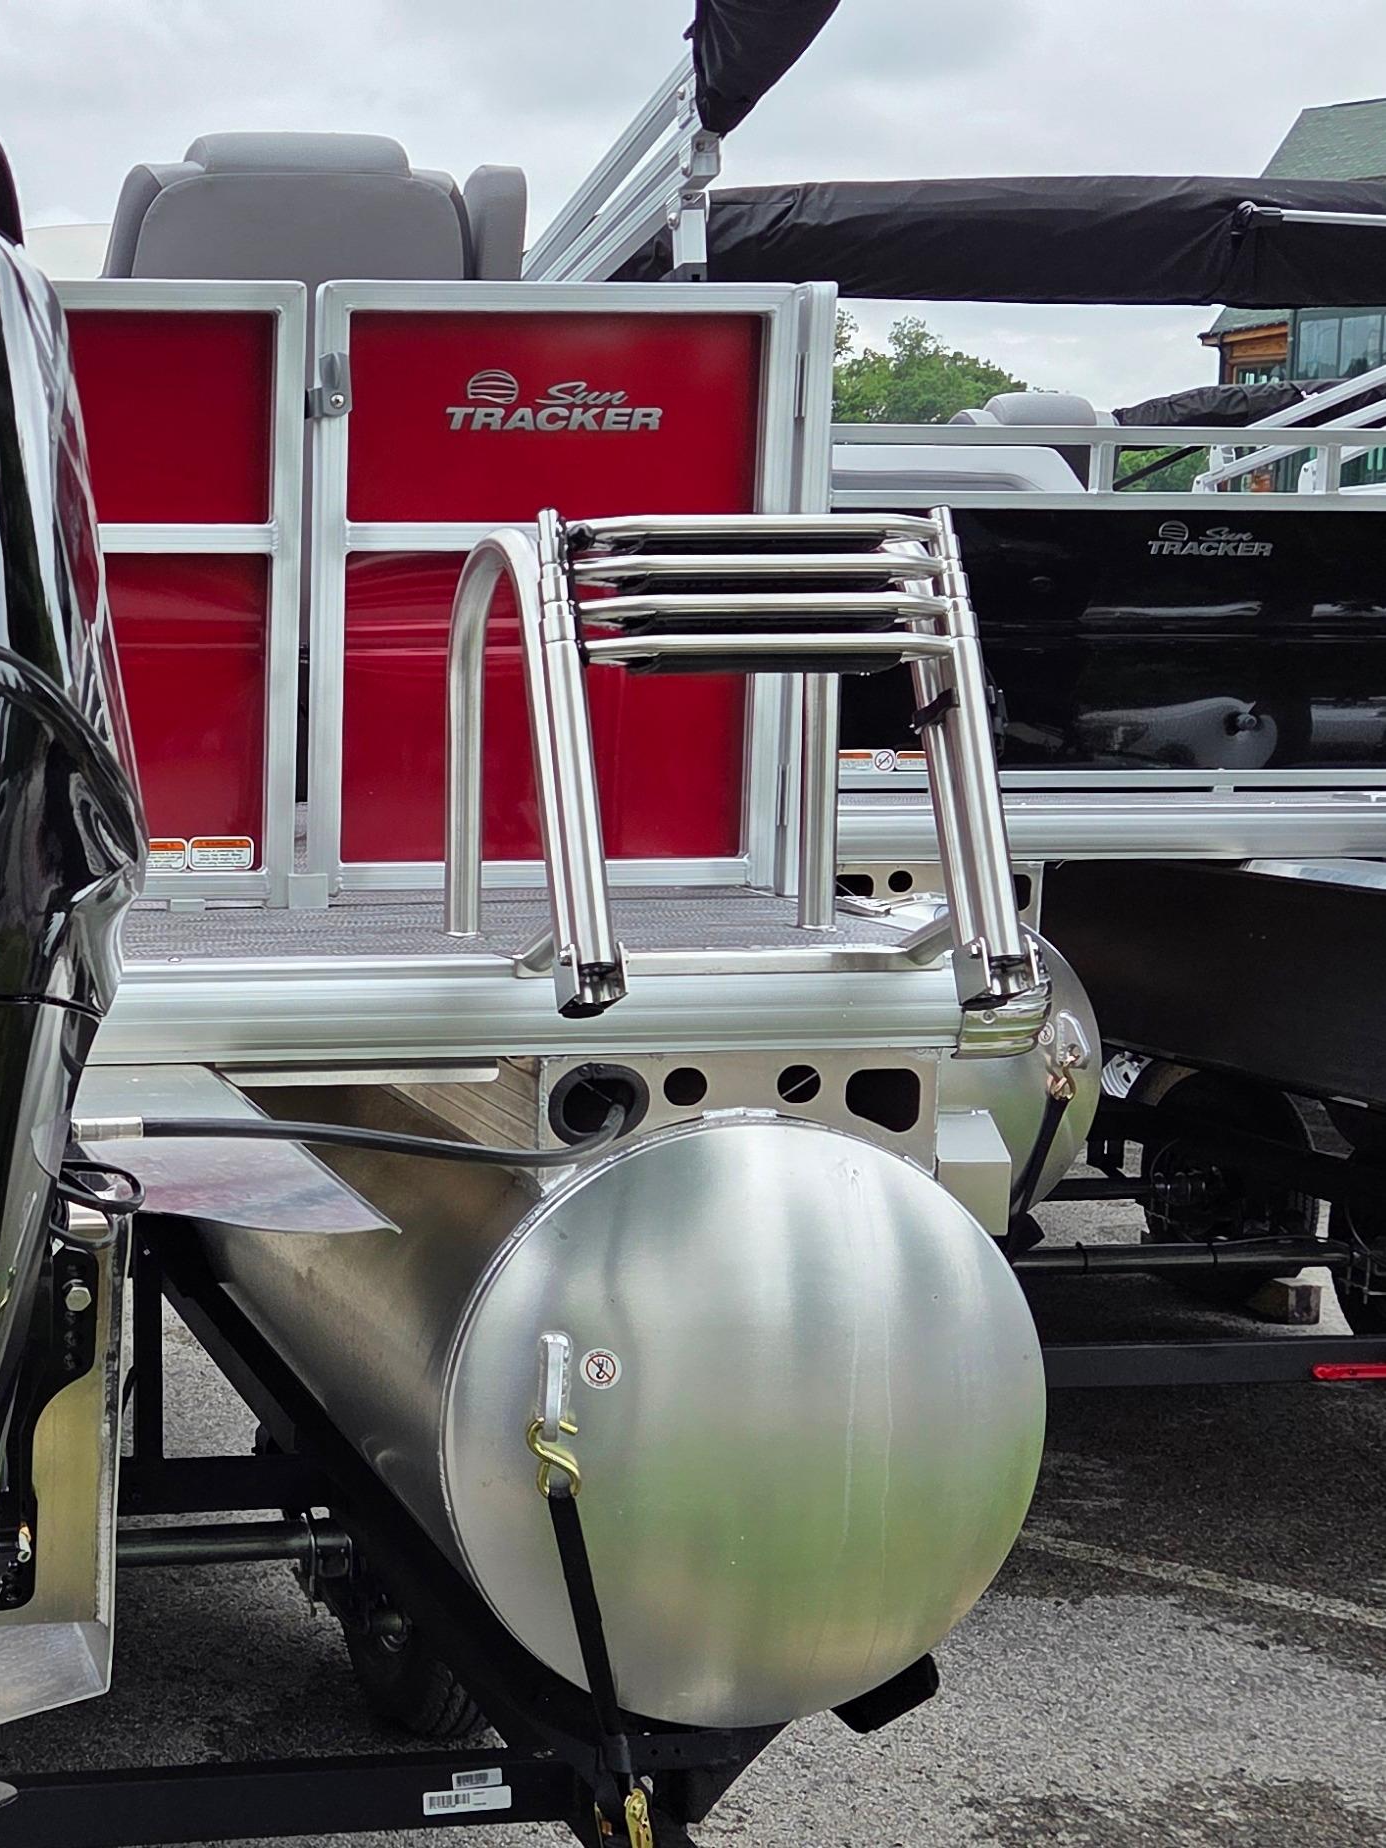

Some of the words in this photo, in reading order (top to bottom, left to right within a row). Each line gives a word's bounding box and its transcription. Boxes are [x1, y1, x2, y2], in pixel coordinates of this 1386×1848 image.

[535, 381, 629, 405] Sun
[446, 407, 663, 431] TRACKER
[1199, 526, 1253, 541] Sun
[1148, 540, 1273, 556] TRACKER
